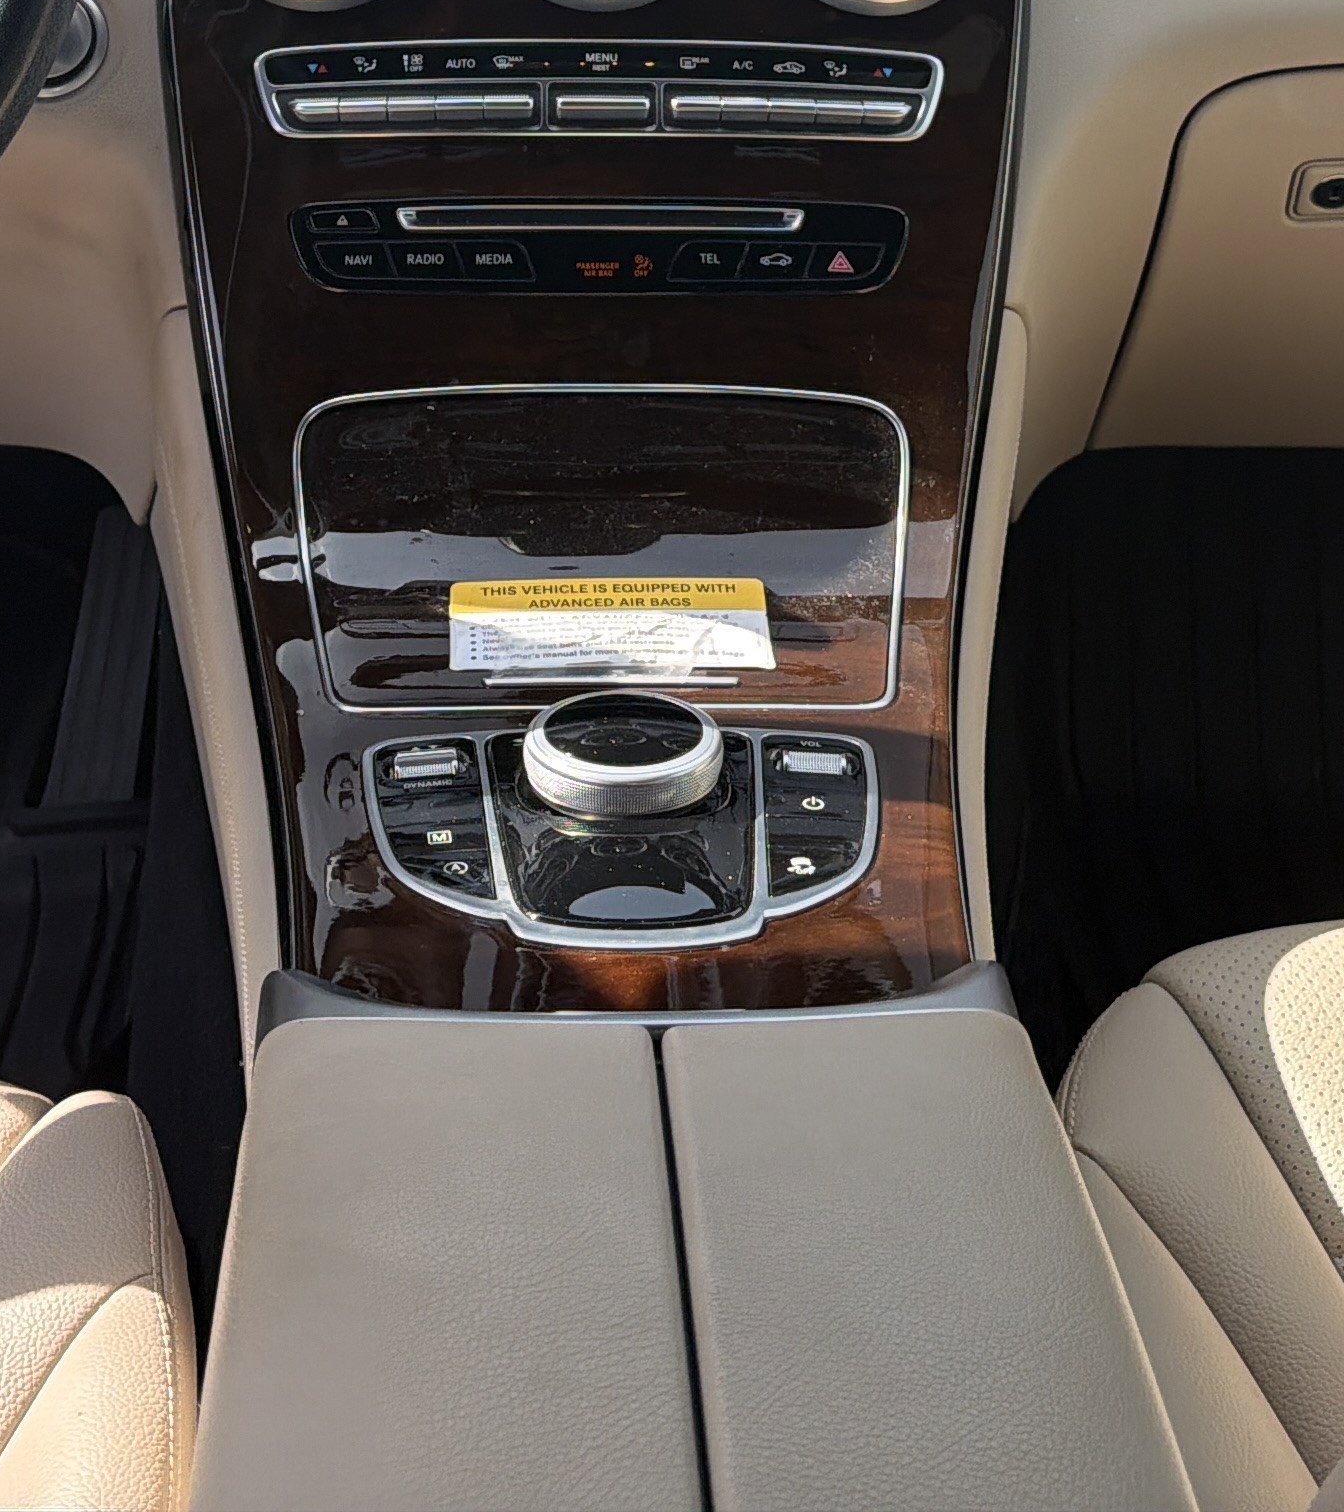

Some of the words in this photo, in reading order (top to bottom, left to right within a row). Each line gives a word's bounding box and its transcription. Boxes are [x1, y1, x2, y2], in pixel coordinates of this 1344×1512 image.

[445, 58, 476, 69] AUTO
[585, 53, 618, 63] MENU
[732, 60, 754, 70] A/C
[344, 254, 373, 266] NAVI
[406, 253, 444, 265] RADIO
[475, 253, 513, 265] MEDIA
[699, 252, 720, 264] TEL
[481, 586, 518, 597] THIS
[522, 584, 589, 596] VEHICLE
[593, 583, 608, 594] IS
[612, 583, 691, 594] EQUIPPED
[695, 583, 736, 594] WITH
[529, 597, 614, 608] ADVANCED
[619, 597, 645, 607] AIR
[650, 596, 692, 607] BAGS
[543, 650, 578, 658] manual
[595, 648, 619, 656] more
[403, 779, 453, 789] DYNAMIC
